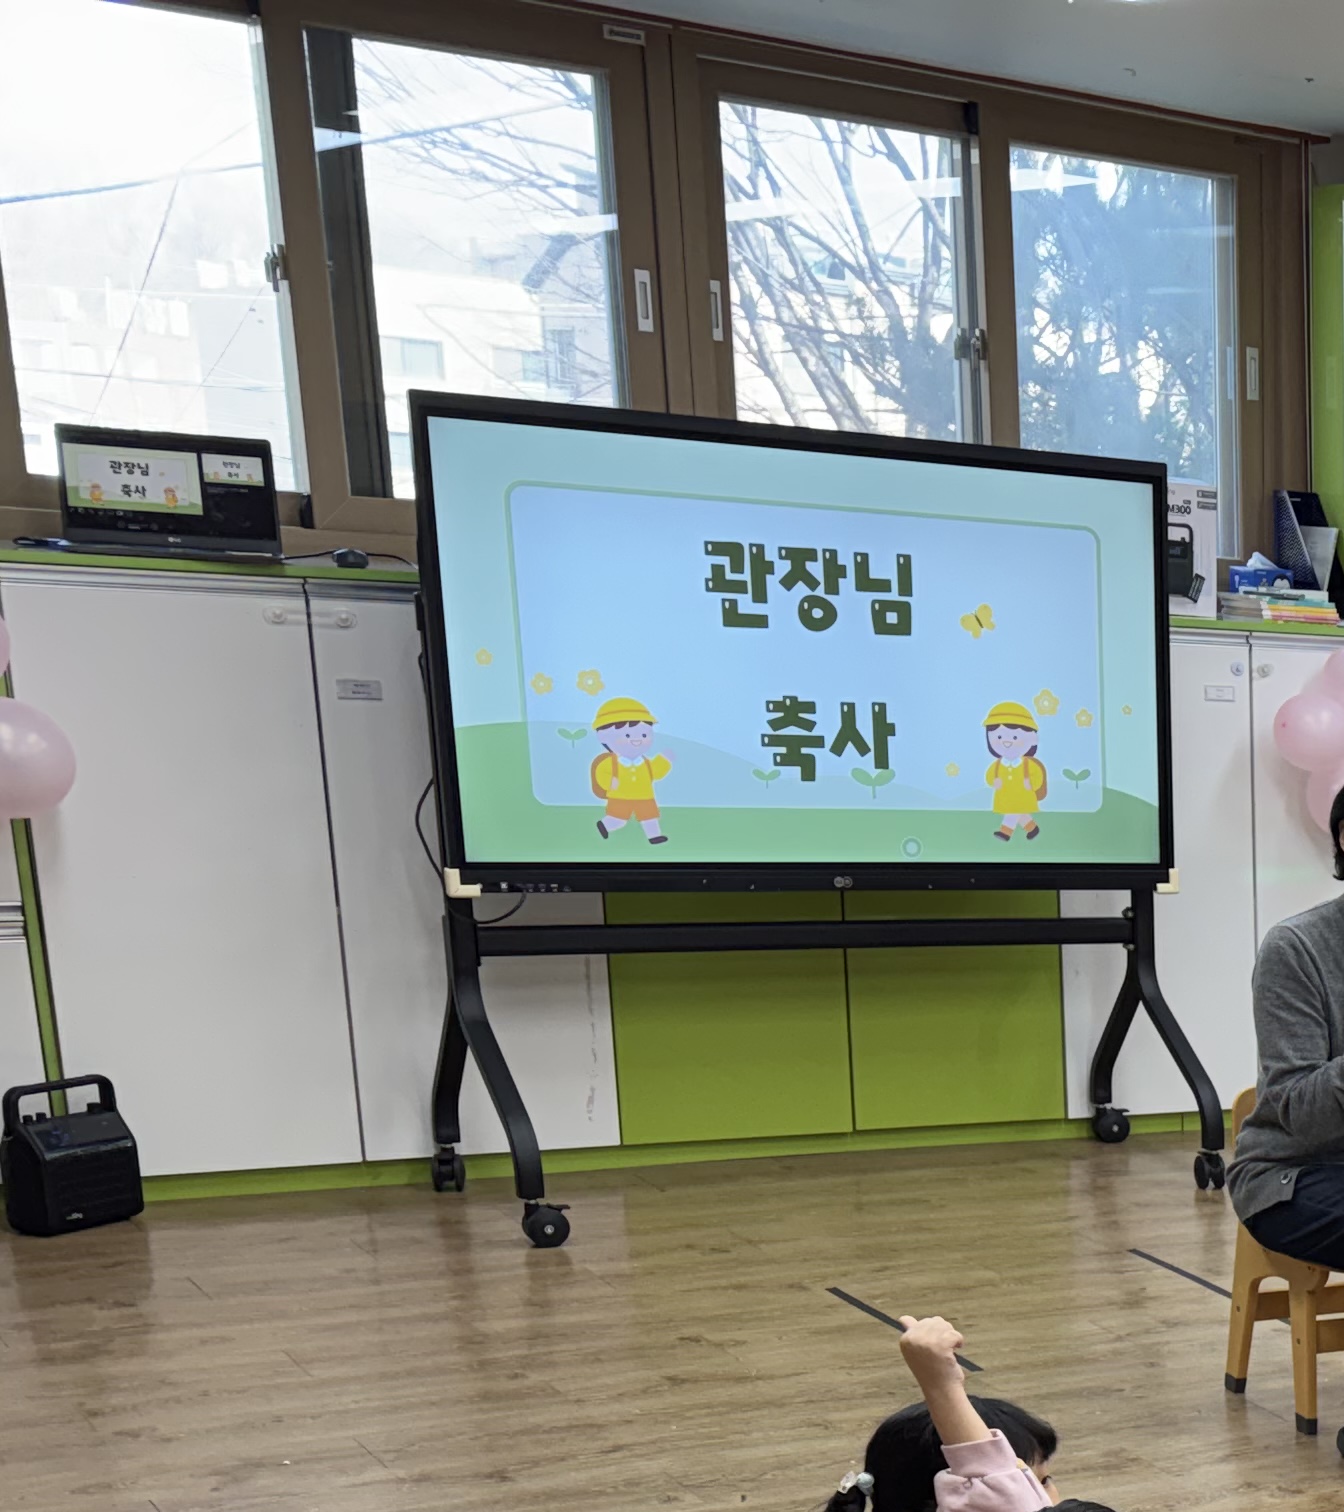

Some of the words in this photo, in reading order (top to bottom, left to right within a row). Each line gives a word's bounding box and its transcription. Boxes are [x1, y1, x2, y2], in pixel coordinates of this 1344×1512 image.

[108, 459, 150, 477] 관장님
[120, 483, 147, 498] 축사
[703, 539, 913, 637] 관장님
[760, 695, 896, 783] 축사
